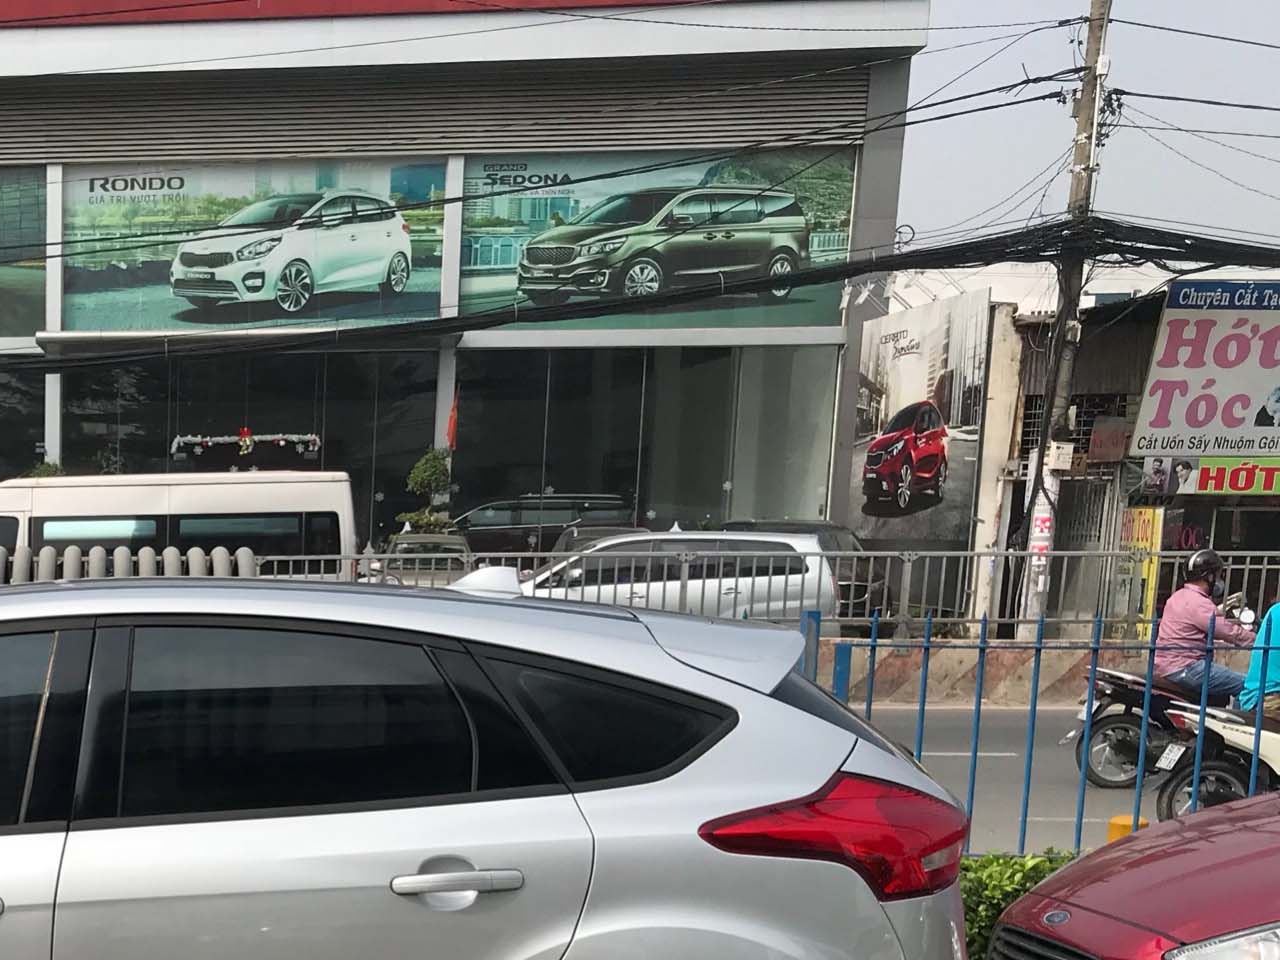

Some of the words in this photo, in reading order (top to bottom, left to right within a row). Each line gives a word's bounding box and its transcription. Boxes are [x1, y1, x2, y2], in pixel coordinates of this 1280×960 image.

[89, 176, 185, 193] RONDO
[483, 173, 573, 186] SEDONA
[1179, 288, 1230, 309] Chuyên
[1234, 283, 1259, 306] Cắt
[1148, 378, 1252, 429] Tóc
[1137, 433, 1157, 450] Cắt
[1161, 432, 1184, 450] Uốn
[1189, 433, 1210, 452] Sấy
[1213, 436, 1254, 452] Nhuộm
[1198, 461, 1280, 492] HỚT
